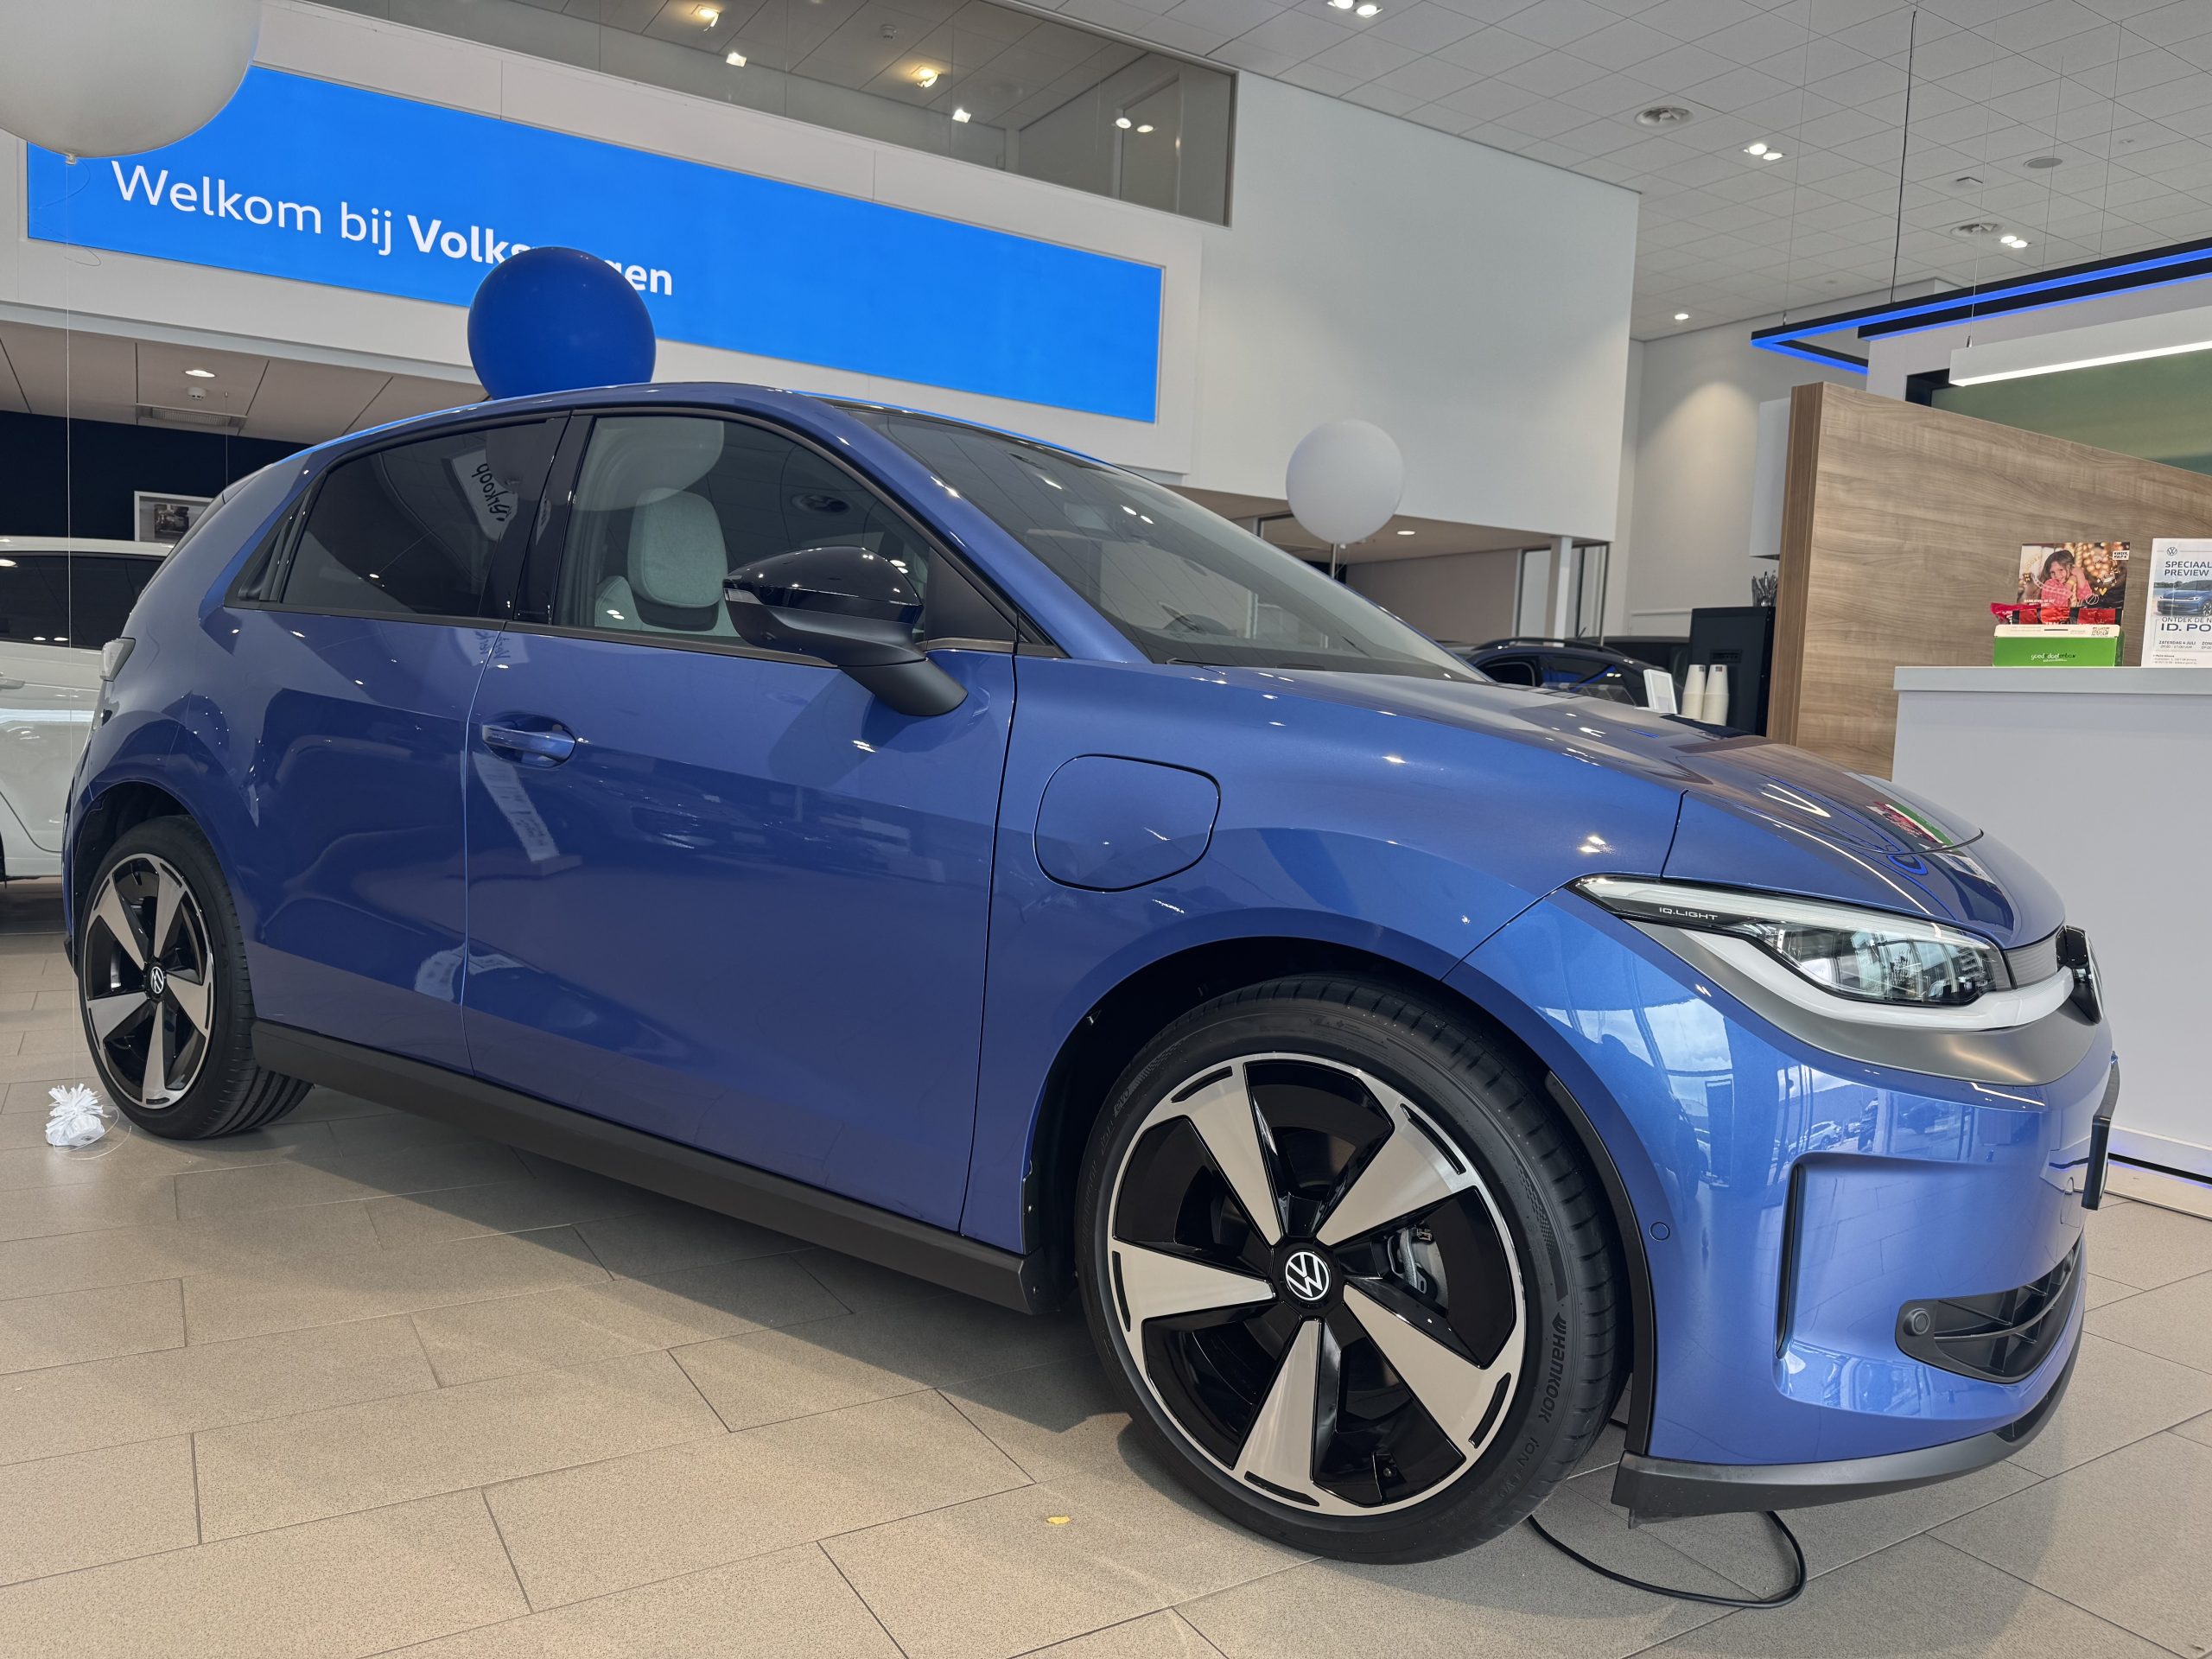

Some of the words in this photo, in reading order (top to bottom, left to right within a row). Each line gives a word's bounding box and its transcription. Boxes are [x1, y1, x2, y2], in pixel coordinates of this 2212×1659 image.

[111, 160, 321, 234] Welkom
[341, 201, 392, 257] bij
[407, 214, 672, 296] Volken
[2161, 623, 2182, 632] ID.
[1659, 907, 1719, 920] IQ.LIGHT
